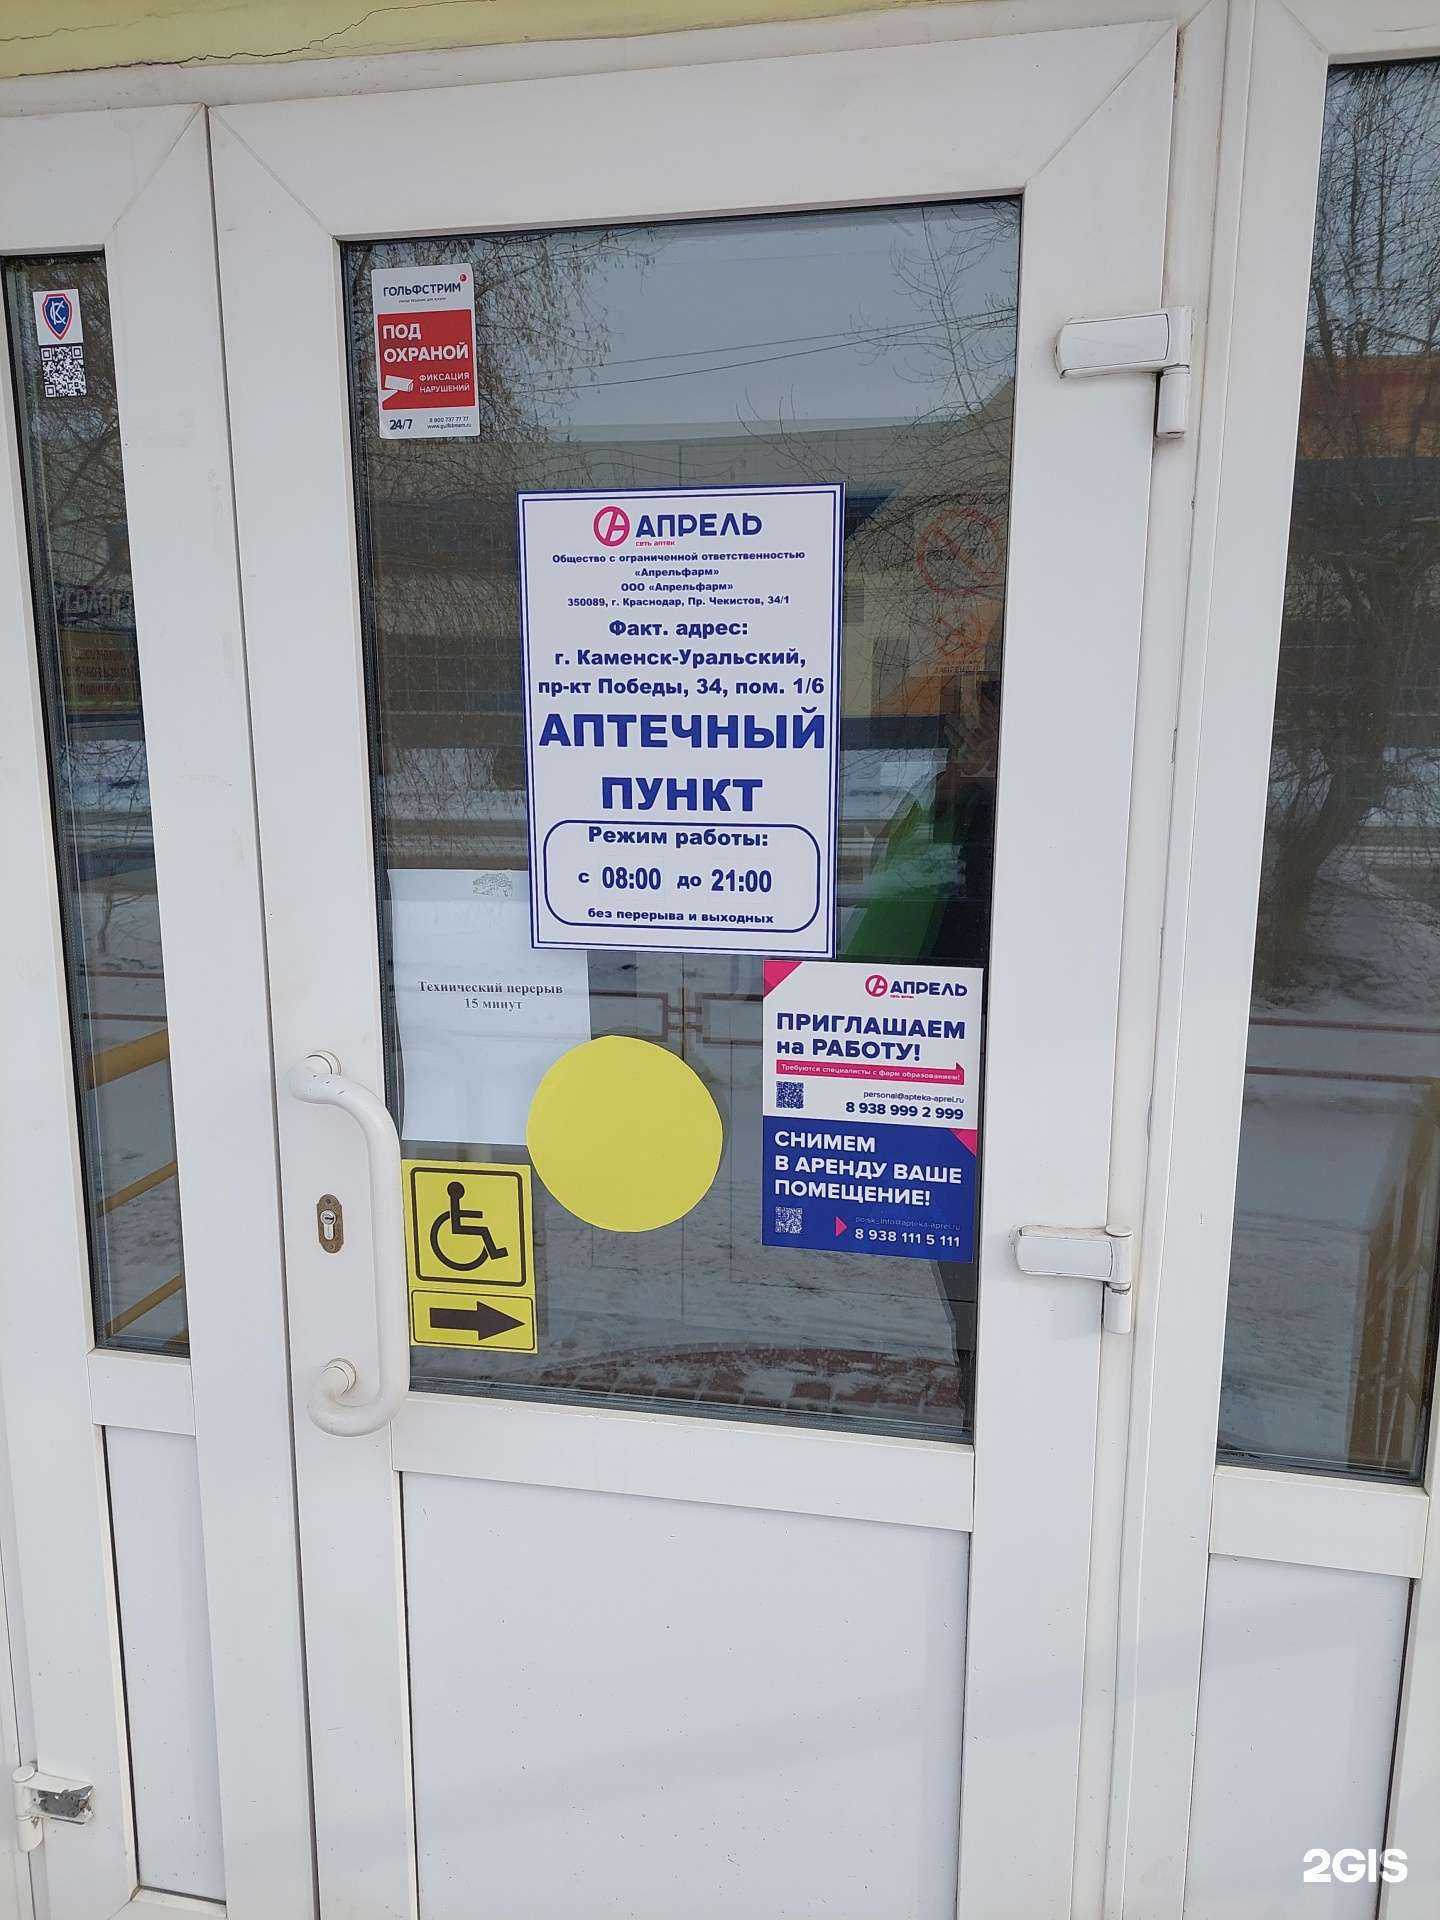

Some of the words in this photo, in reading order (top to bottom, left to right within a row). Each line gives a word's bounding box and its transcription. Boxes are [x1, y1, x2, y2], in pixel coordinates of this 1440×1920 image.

[383, 282, 461, 297] ГОЛЬФСТРИМ
[382, 323, 421, 341] ПОД
[384, 342, 469, 363] ОХРАНОЙ
[419, 373, 470, 382] ФИКСАЦИЯ
[420, 384, 470, 393] НАРУШЕНИЙ
[389, 419, 412, 431] 24/7
[636, 512, 762, 538] АПРЕЛЬ
[552, 554, 606, 564] Общество
[619, 552, 698, 564] ограниченной
[702, 551, 805, 561] ответственностью
[635, 567, 719, 578] «Апрельфарм»
[621, 583, 645, 592] ООО
[649, 582, 733, 593] «Апрельфарм»
[567, 598, 608, 608] 350089,
[623, 597, 685, 608] Краснодар,
[688, 597, 706, 607] Пр.
[709, 596, 764, 606] Чекистов,
[767, 595, 790, 605] 34/1
[609, 620, 669, 636] Факт.
[675, 622, 749, 640] адрес:
[555, 653, 570, 665] г.
[577, 648, 806, 669] Каменск-Уральский,
[538, 682, 591, 698] пр-кт
[598, 678, 689, 698] Победы,
[696, 678, 728, 698] 34,
[735, 681, 785, 695] пом.
[793, 677, 825, 694] 1/6
[539, 706, 825, 749] АПТЕЧНЫЙ
[601, 777, 763, 812] ПУНКТ
[588, 826, 668, 845] Режим
[675, 829, 768, 849] работы:
[578, 871, 590, 884] с
[602, 866, 661, 891] 08:00
[676, 873, 702, 889] до
[711, 869, 772, 893] 21:00
[588, 907, 612, 919] без
[616, 910, 684, 924] перерыва
[688, 913, 697, 921] и
[702, 912, 774, 924] выходных
[418, 981, 502, 993] Технический
[507, 985, 563, 996] перерыв
[890, 980, 968, 997] АПРЕЛЬ
[465, 998, 479, 1009] 15
[482, 1000, 523, 1012] минут
[777, 1012, 966, 1039] ПРИГЛАШАЕМ
[776, 1041, 804, 1055] на
[813, 1039, 921, 1061] РАБОТУ!
[781, 1064, 821, 1074] Требуются
[822, 1066, 871, 1076] специалисты
[879, 1069, 900, 1078] фарм
[863, 1091, 965, 1104] personal@apteka-aprel.ru
[845, 1102, 855, 1113] 8
[858, 1103, 886, 1115] 938
[890, 1104, 918, 1117] 999
[922, 1107, 931, 1117] 2
[935, 1107, 964, 1120] 999
[775, 1131, 876, 1152] СНИМЕМ
[775, 1155, 789, 1171] В
[795, 1157, 887, 1180] АРЕНДУ
[893, 1164, 962, 1184] ВАШЕ
[775, 1179, 931, 1206] ПОМЕЩЕНИЕ!
[855, 1228, 864, 1239] 8
[868, 1230, 897, 1242] 938
[902, 1232, 921, 1244] 111
[926, 1234, 935, 1245] 5
[940, 1235, 961, 1247] 111
